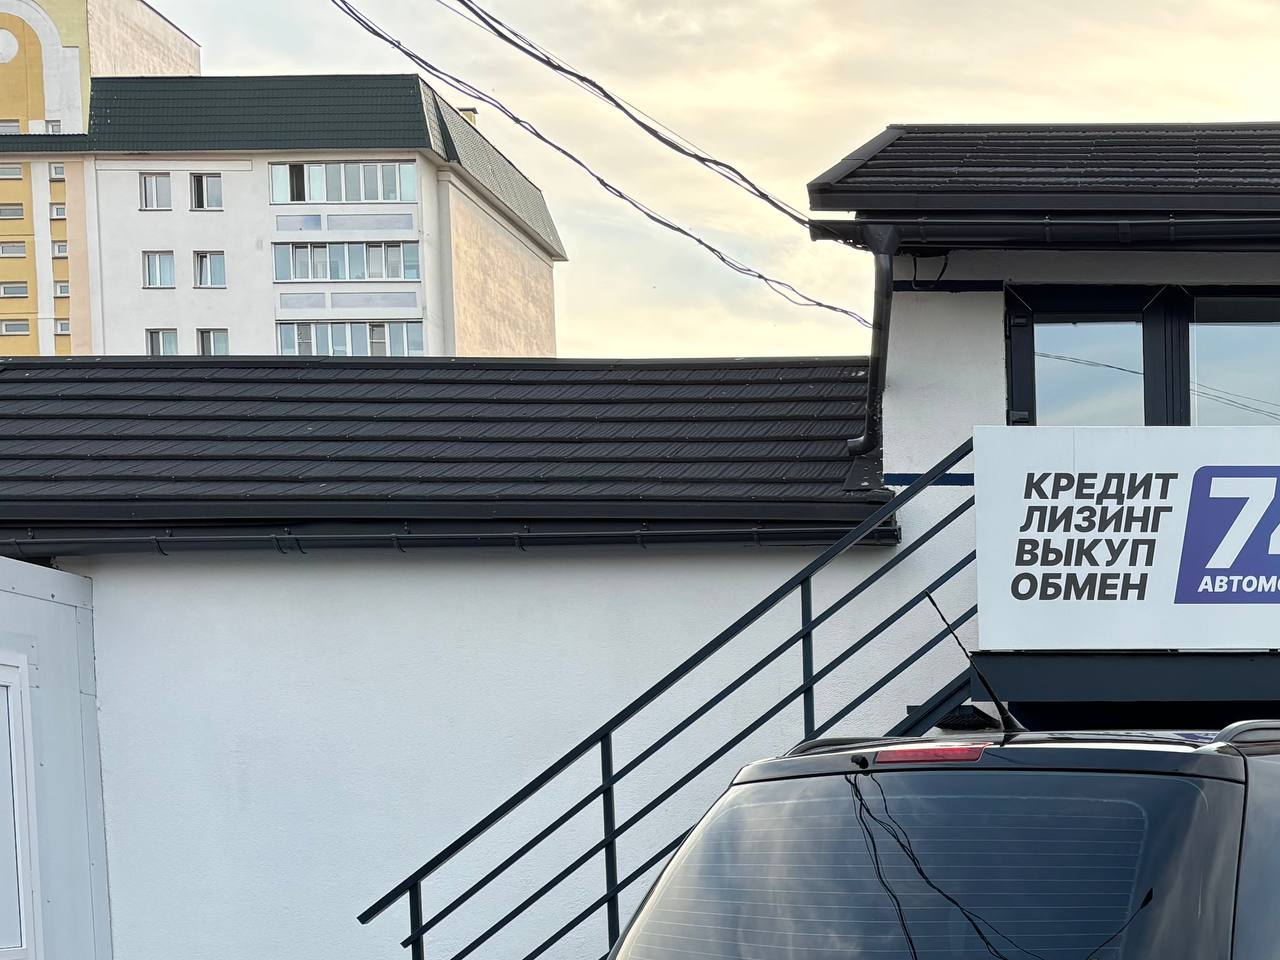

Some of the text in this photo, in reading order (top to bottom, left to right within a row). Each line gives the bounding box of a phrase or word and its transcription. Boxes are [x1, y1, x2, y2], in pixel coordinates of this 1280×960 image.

[1023, 472, 1179, 505] КРЕДИТ
[1019, 505, 1173, 533] ЛИЗИНГ
[1015, 538, 1157, 567] ВЫКУП
[1010, 572, 1149, 601] ОБМЕН
